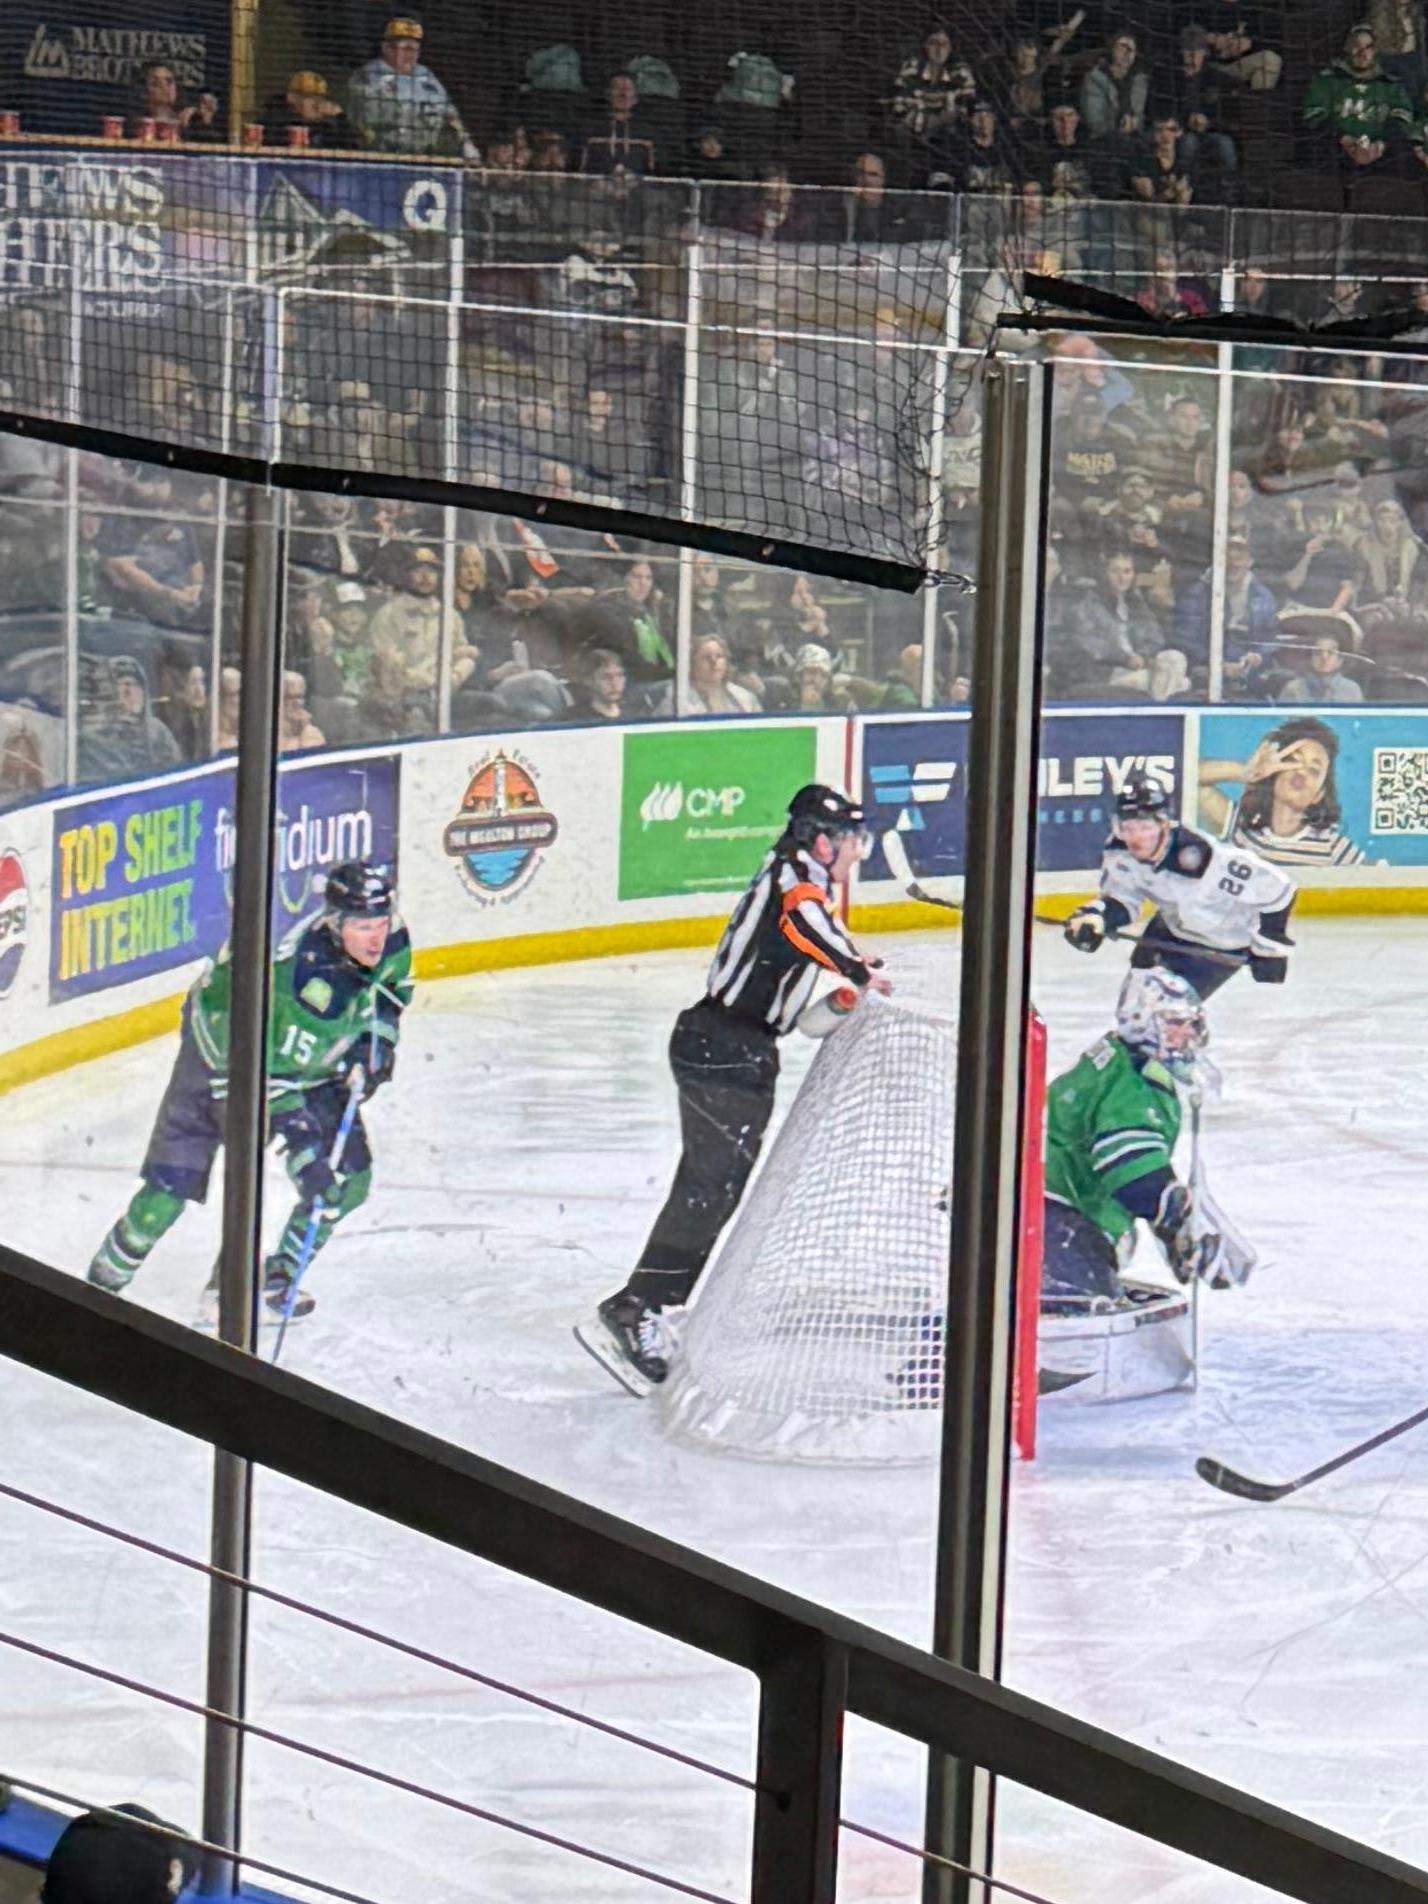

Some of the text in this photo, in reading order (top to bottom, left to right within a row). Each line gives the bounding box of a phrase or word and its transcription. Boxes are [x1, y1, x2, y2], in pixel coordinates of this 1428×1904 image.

[70, 26, 207, 59] MATHEWS
[402, 180, 448, 231] Q
[685, 785, 746, 818] CMP
[58, 799, 203, 899] TOP SHELF
[1217, 859, 1253, 897] 26
[281, 1024, 319, 1066] 15
